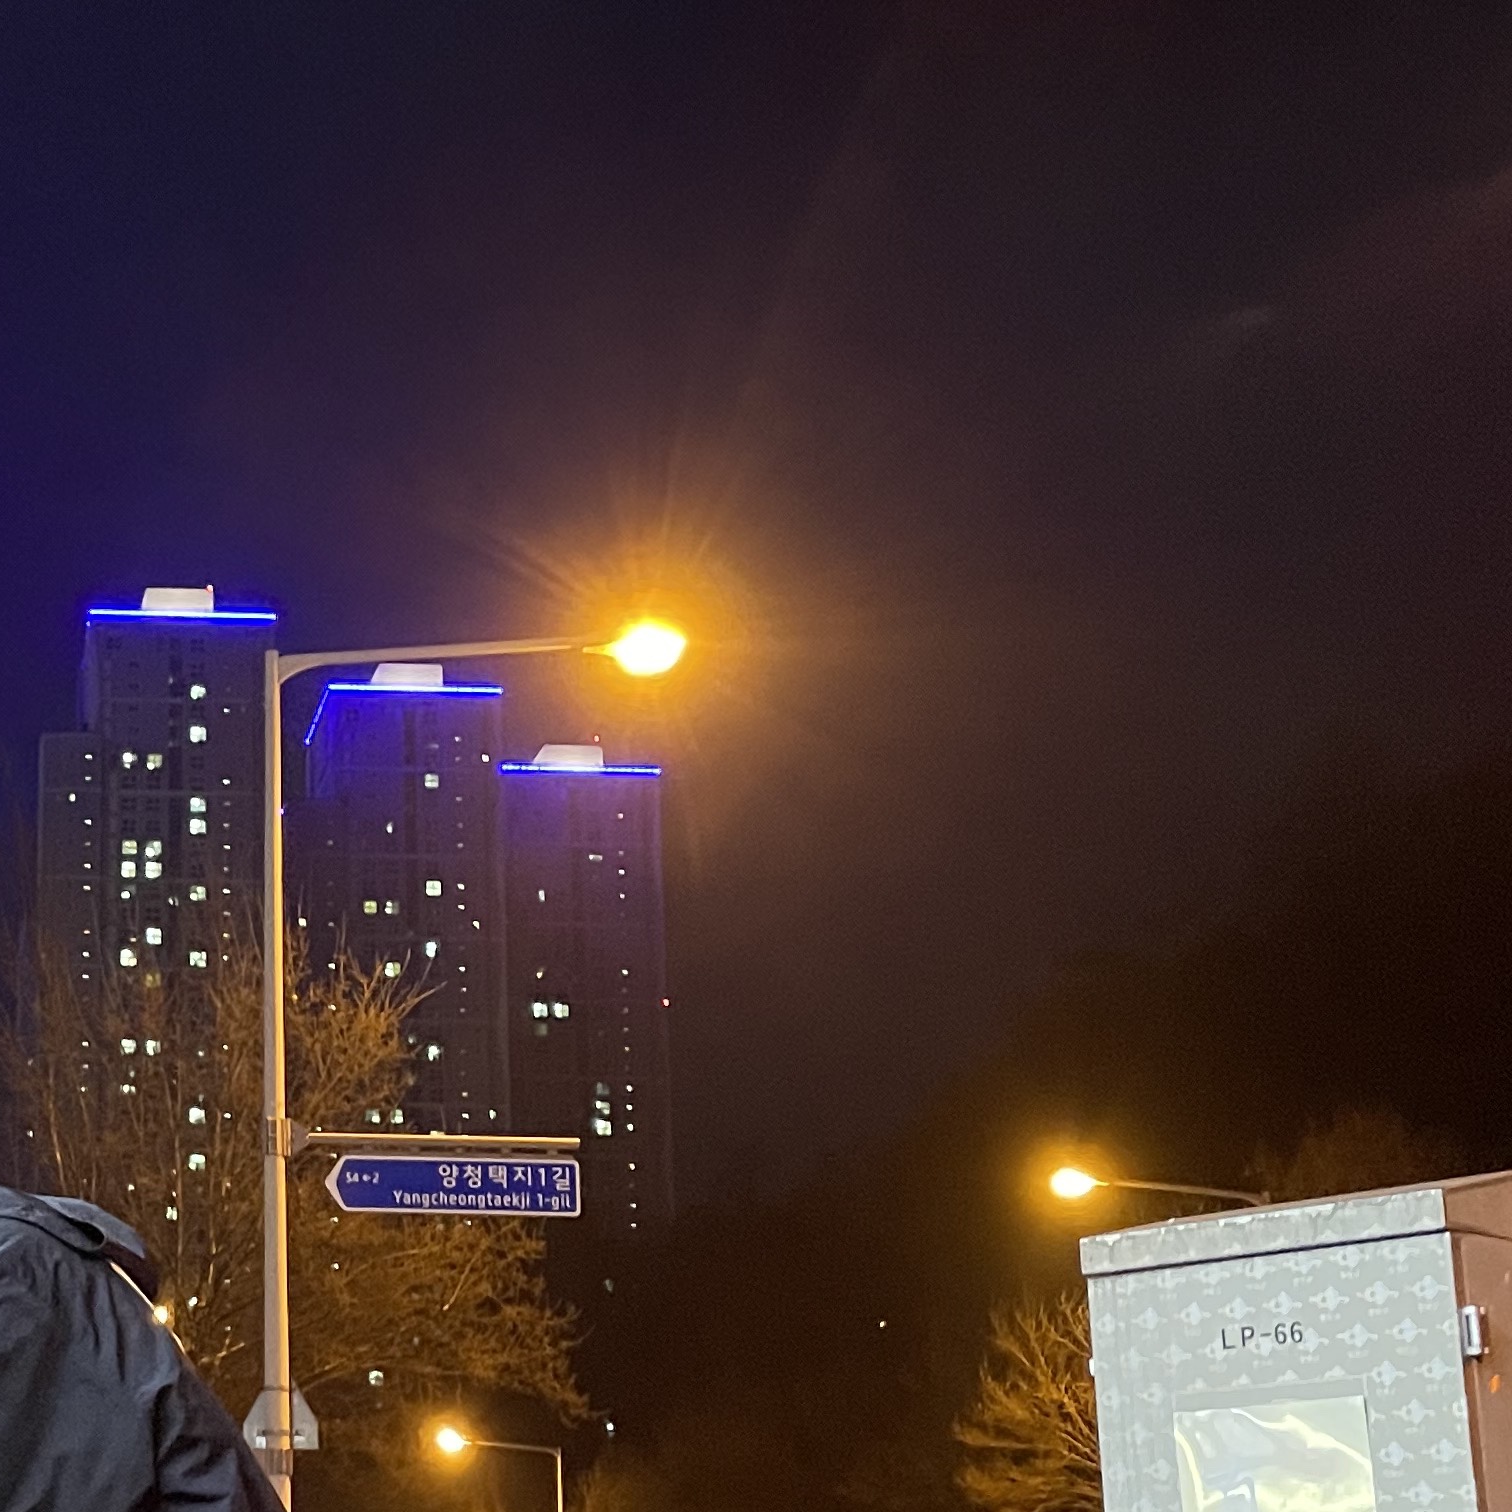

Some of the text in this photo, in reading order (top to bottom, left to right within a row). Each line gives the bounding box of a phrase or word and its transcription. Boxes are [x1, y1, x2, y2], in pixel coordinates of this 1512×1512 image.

[438, 1163, 571, 1192] 양청택지1길
[393, 1190, 571, 1210] Yangcheongtaekji 1-gil
[1220, 1320, 1304, 1351] LP-66
